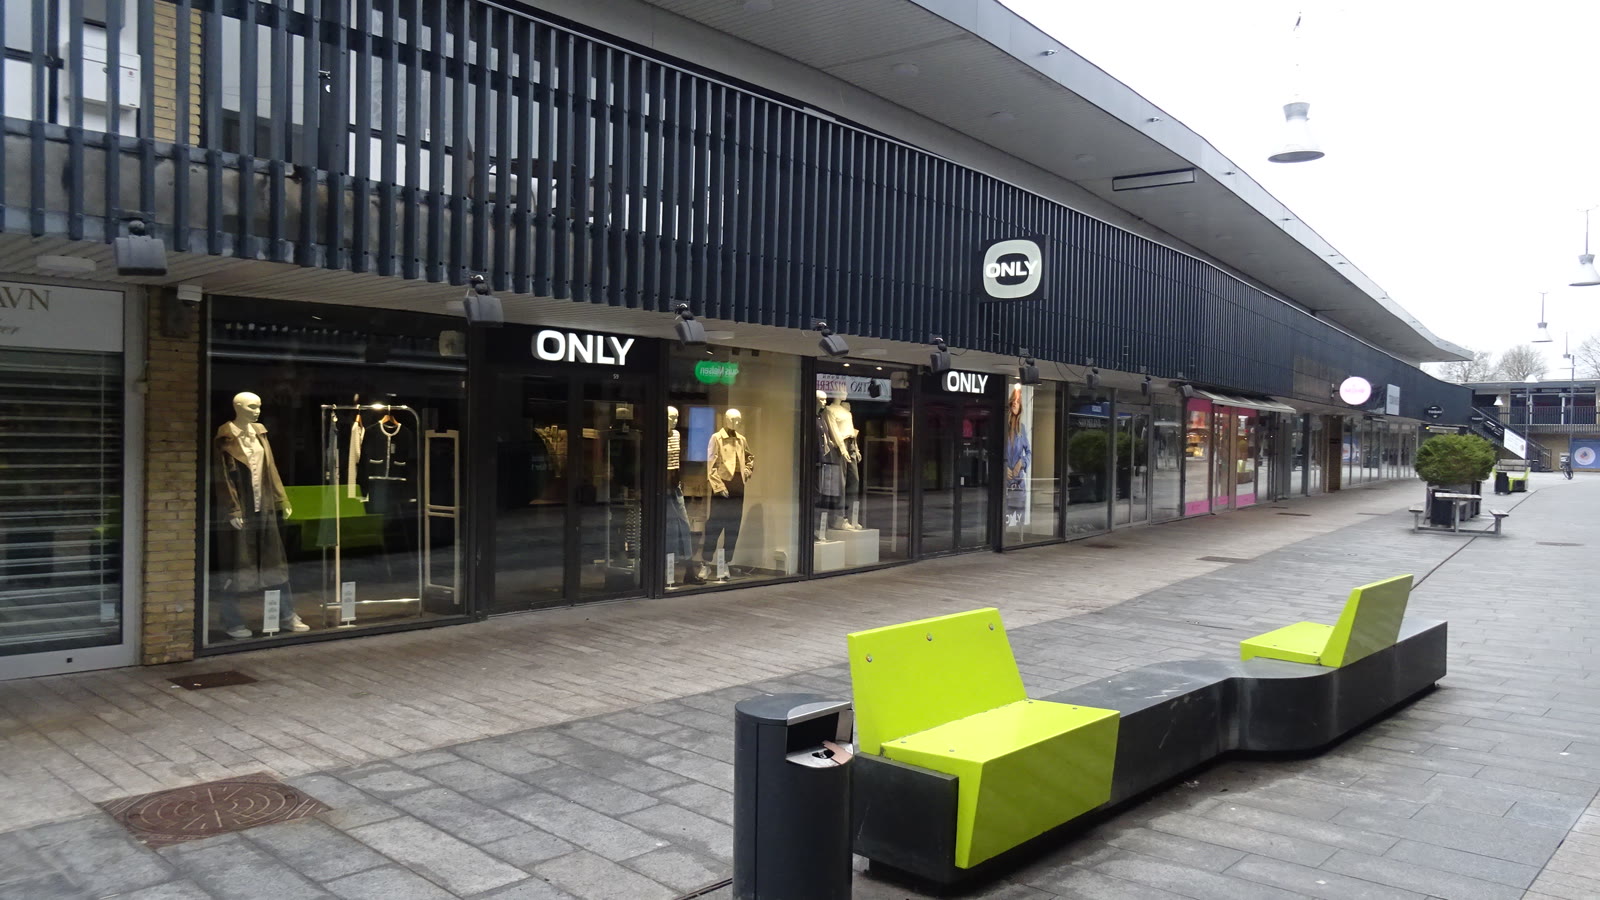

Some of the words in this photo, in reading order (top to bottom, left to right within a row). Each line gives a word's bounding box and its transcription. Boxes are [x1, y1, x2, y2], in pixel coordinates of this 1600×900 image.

[986, 260, 1038, 278] ONLY
[533, 329, 635, 366] ONLY
[946, 371, 989, 394] ONLY
